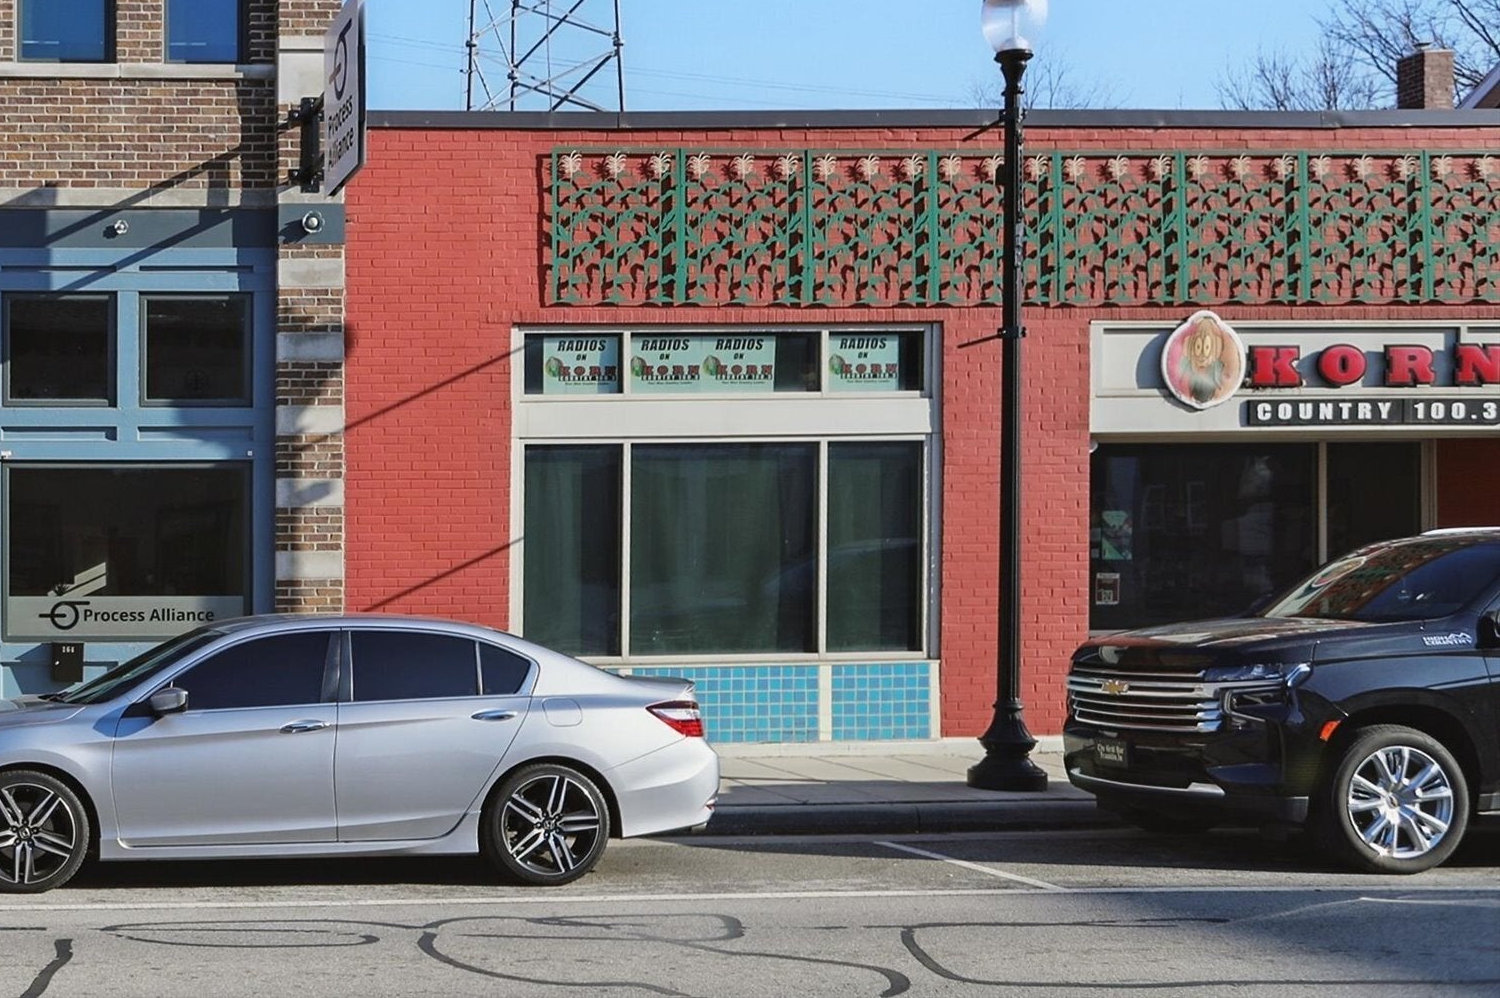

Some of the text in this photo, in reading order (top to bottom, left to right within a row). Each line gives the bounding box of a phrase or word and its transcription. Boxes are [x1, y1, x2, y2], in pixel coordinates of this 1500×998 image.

[328, 94, 353, 135] Process
[328, 128, 354, 169] Alliance
[557, 339, 606, 351] RADIOS
[641, 338, 690, 351] RADIOS
[715, 338, 764, 351] RADIOS
[839, 337, 887, 350] RADIOS
[1248, 343, 1500, 389] KORN
[1257, 402, 1498, 421] COUNTRY 100.3
[83, 607, 215, 623] Process Alliance
